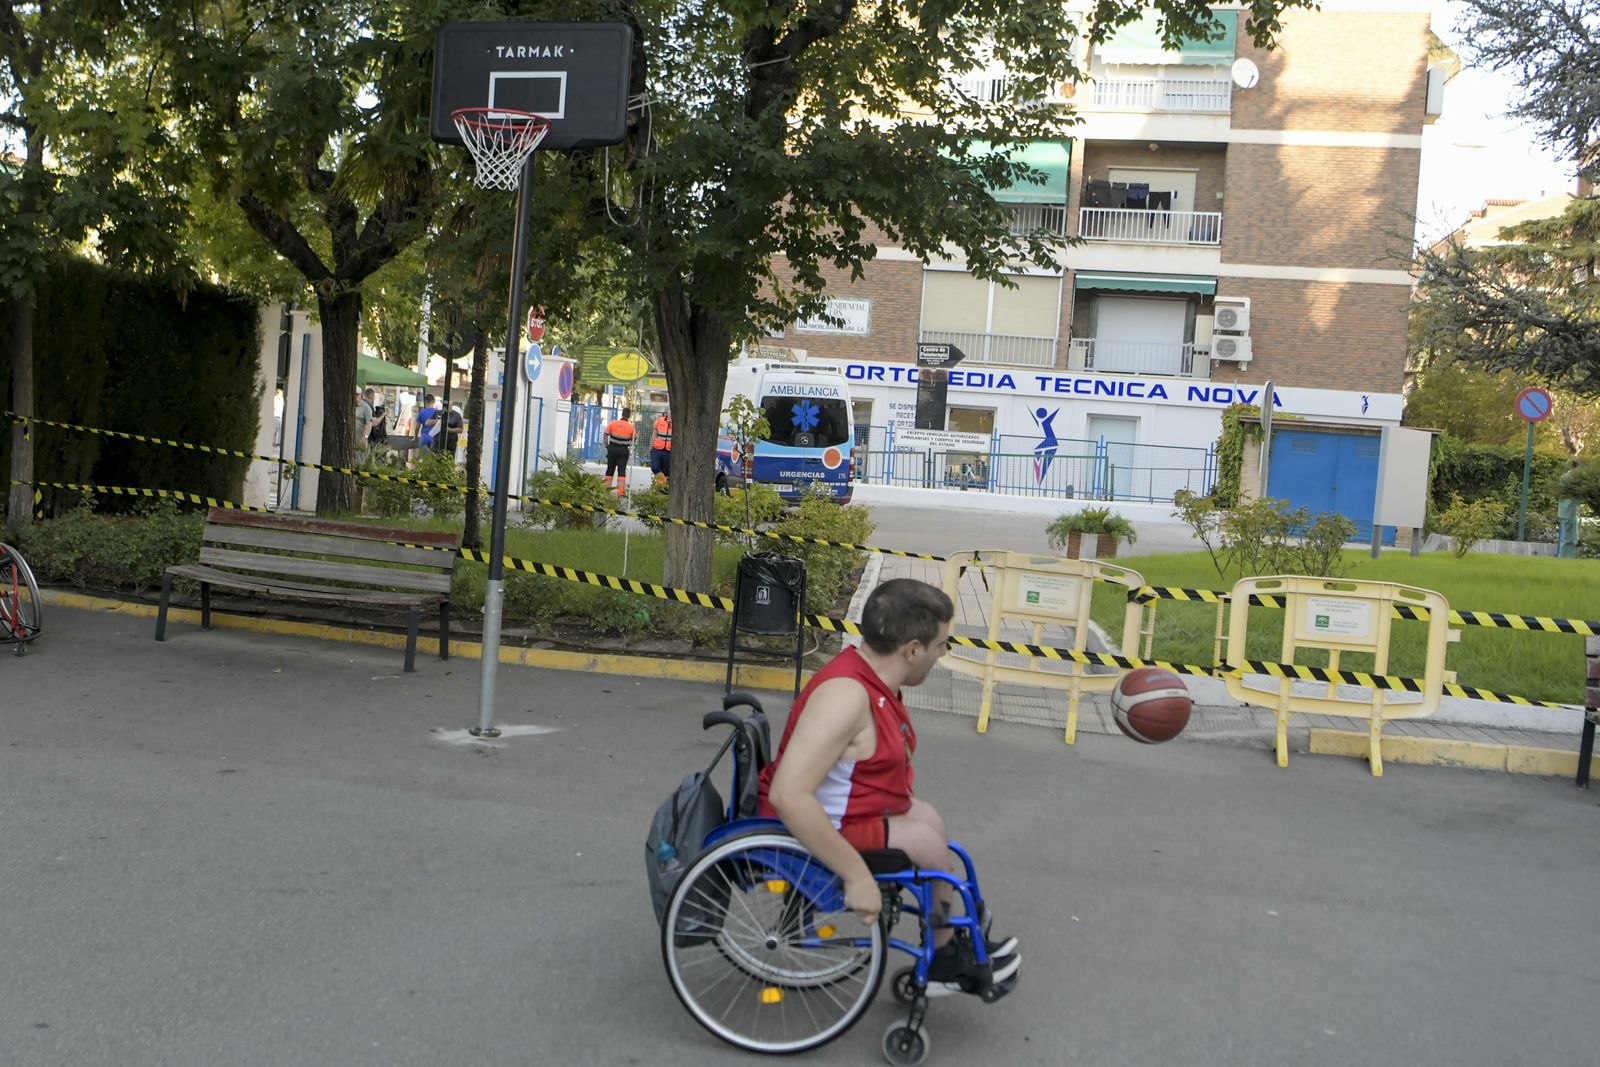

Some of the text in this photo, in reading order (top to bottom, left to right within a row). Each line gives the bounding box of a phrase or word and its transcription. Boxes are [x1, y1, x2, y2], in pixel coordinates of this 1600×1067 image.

[496, 45, 564, 58] TARMAK
[846, 365, 1016, 389] ORTOEDIA
[1035, 376, 1168, 399] TECNICA
[769, 385, 839, 397] AMBULANCIA
